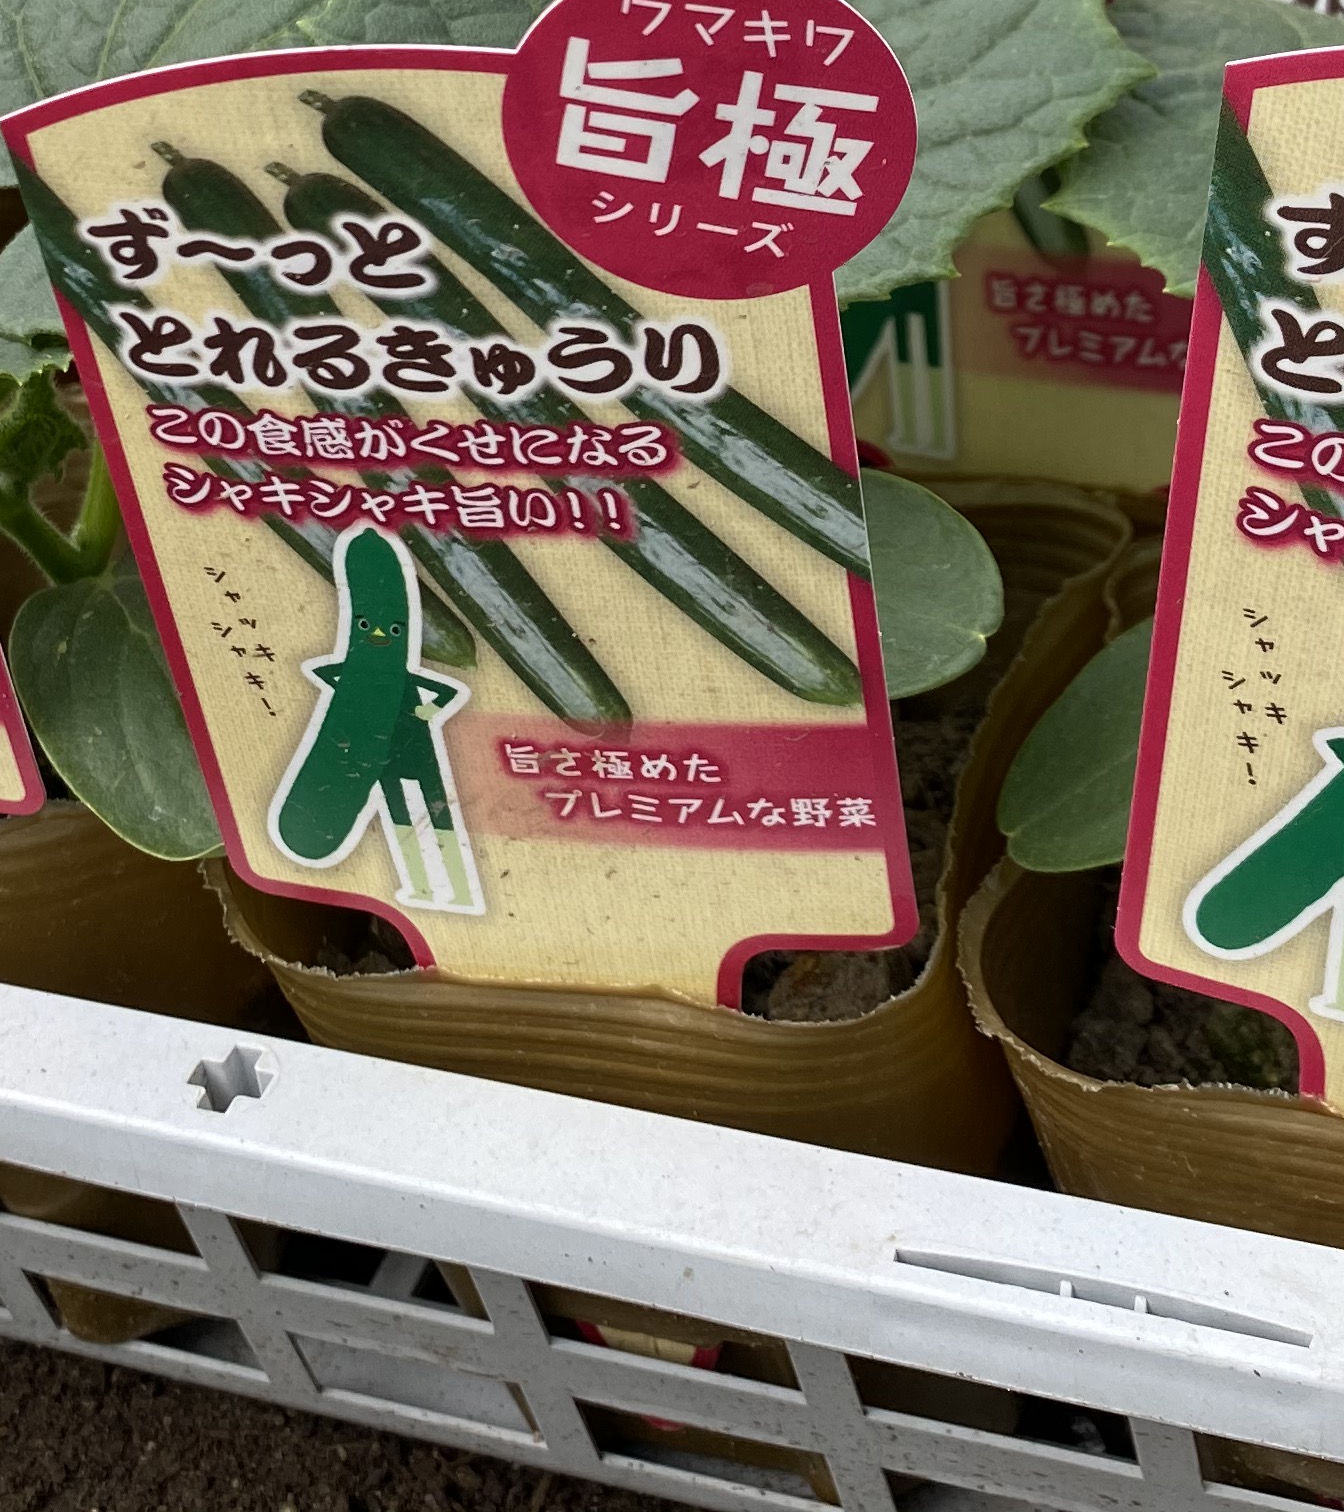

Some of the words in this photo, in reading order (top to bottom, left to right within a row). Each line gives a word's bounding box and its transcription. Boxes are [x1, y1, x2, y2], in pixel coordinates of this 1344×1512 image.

[554, 36, 880, 219] 旨極
[590, 190, 795, 260] シリーズ
[990, 278, 1155, 323] 旨さ極めた
[120, 311, 723, 397] とれるきゅうり
[148, 406, 668, 467] この食感がくせになる
[503, 744, 723, 785] 旨さ極めた
[544, 790, 877, 831] プレミアムな野菜
